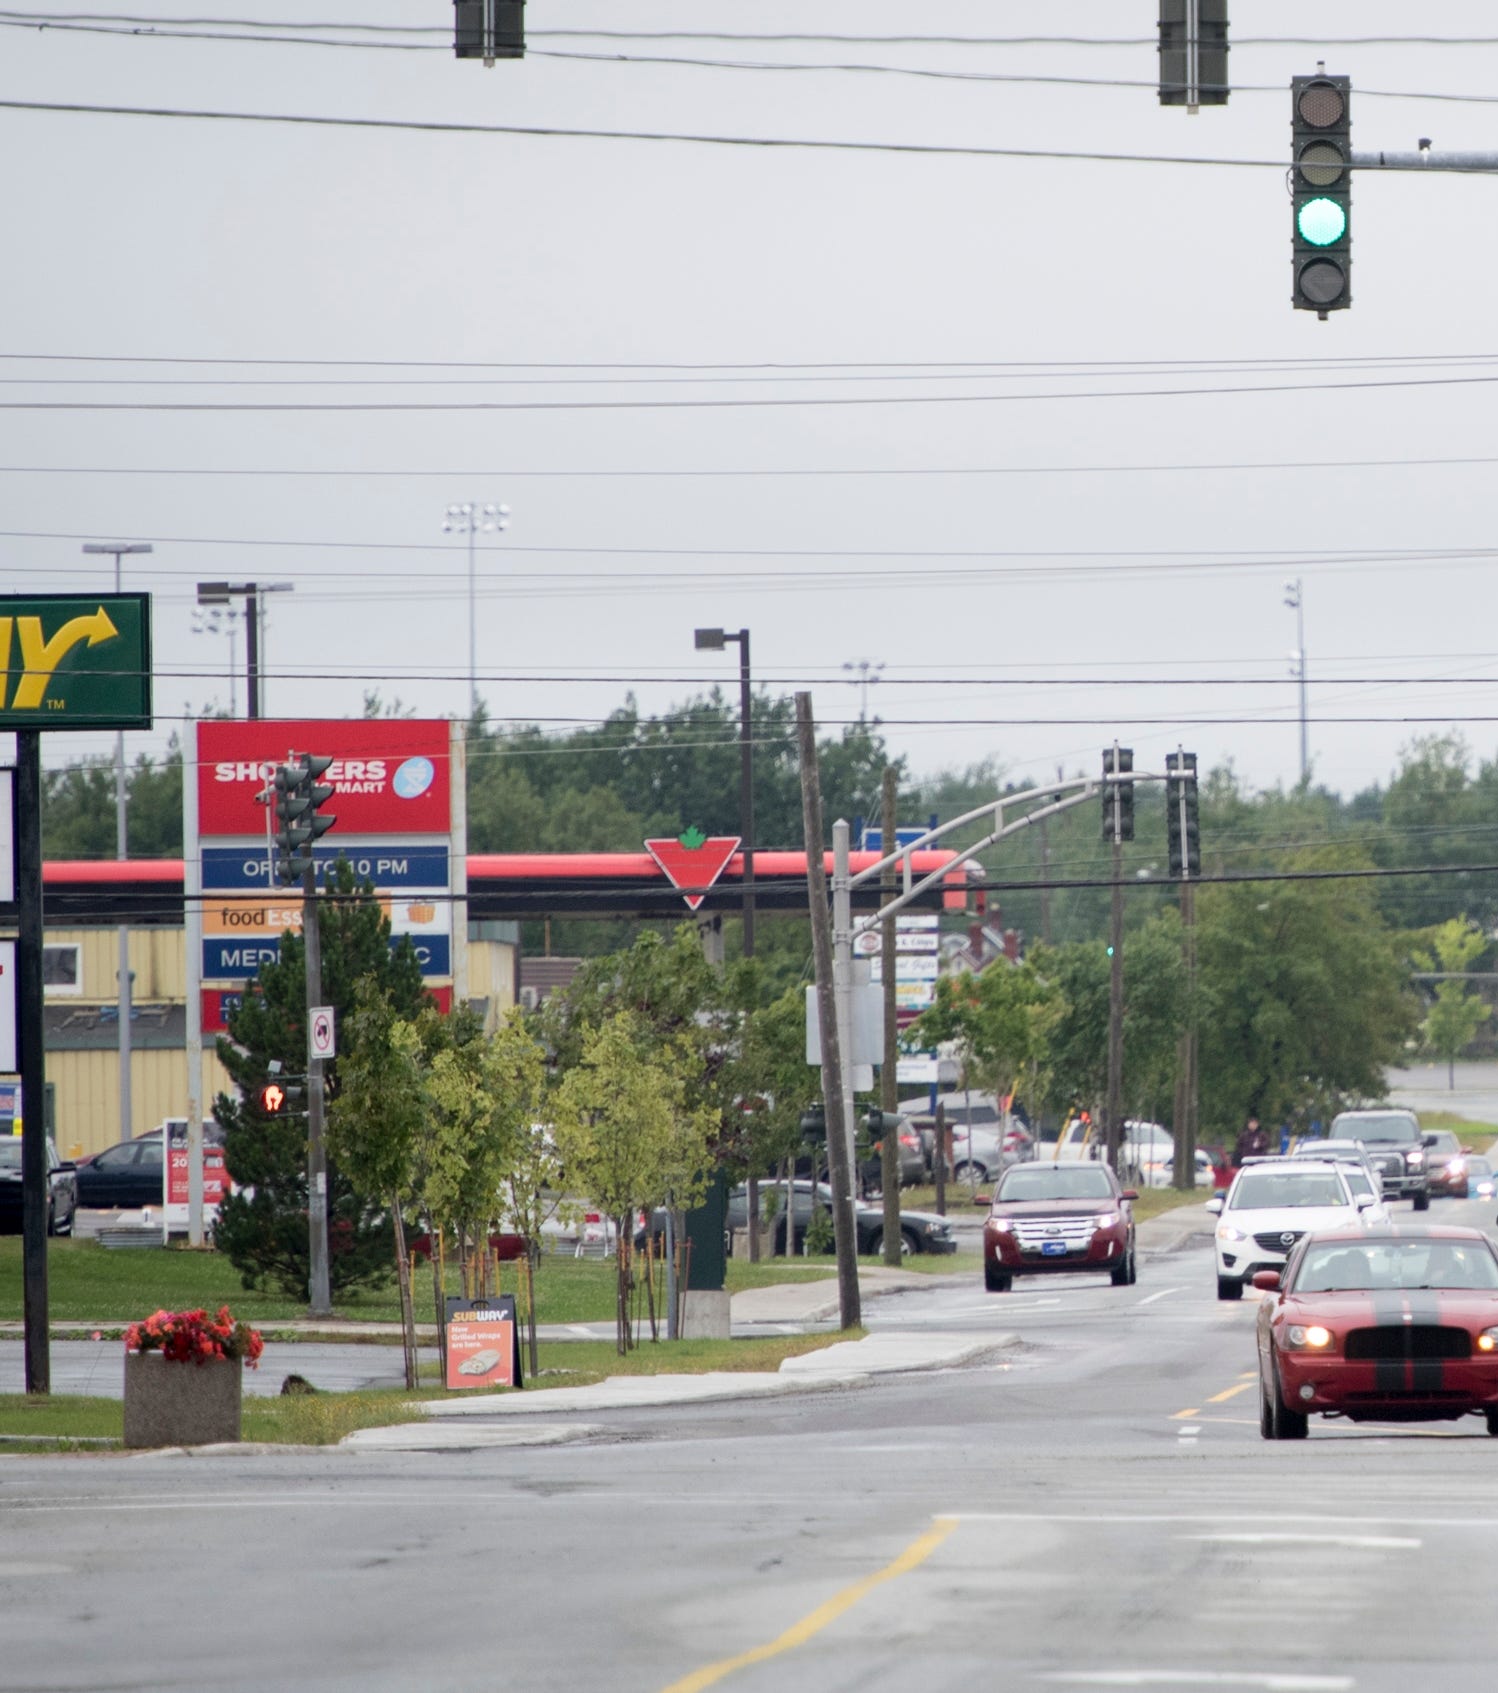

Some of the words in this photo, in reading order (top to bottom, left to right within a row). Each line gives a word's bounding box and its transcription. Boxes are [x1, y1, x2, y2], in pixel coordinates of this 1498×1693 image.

[215, 760, 387, 781] SHOERS
[335, 781, 386, 793] MART
[377, 860, 408, 874] PM
[222, 908, 265, 926] food
